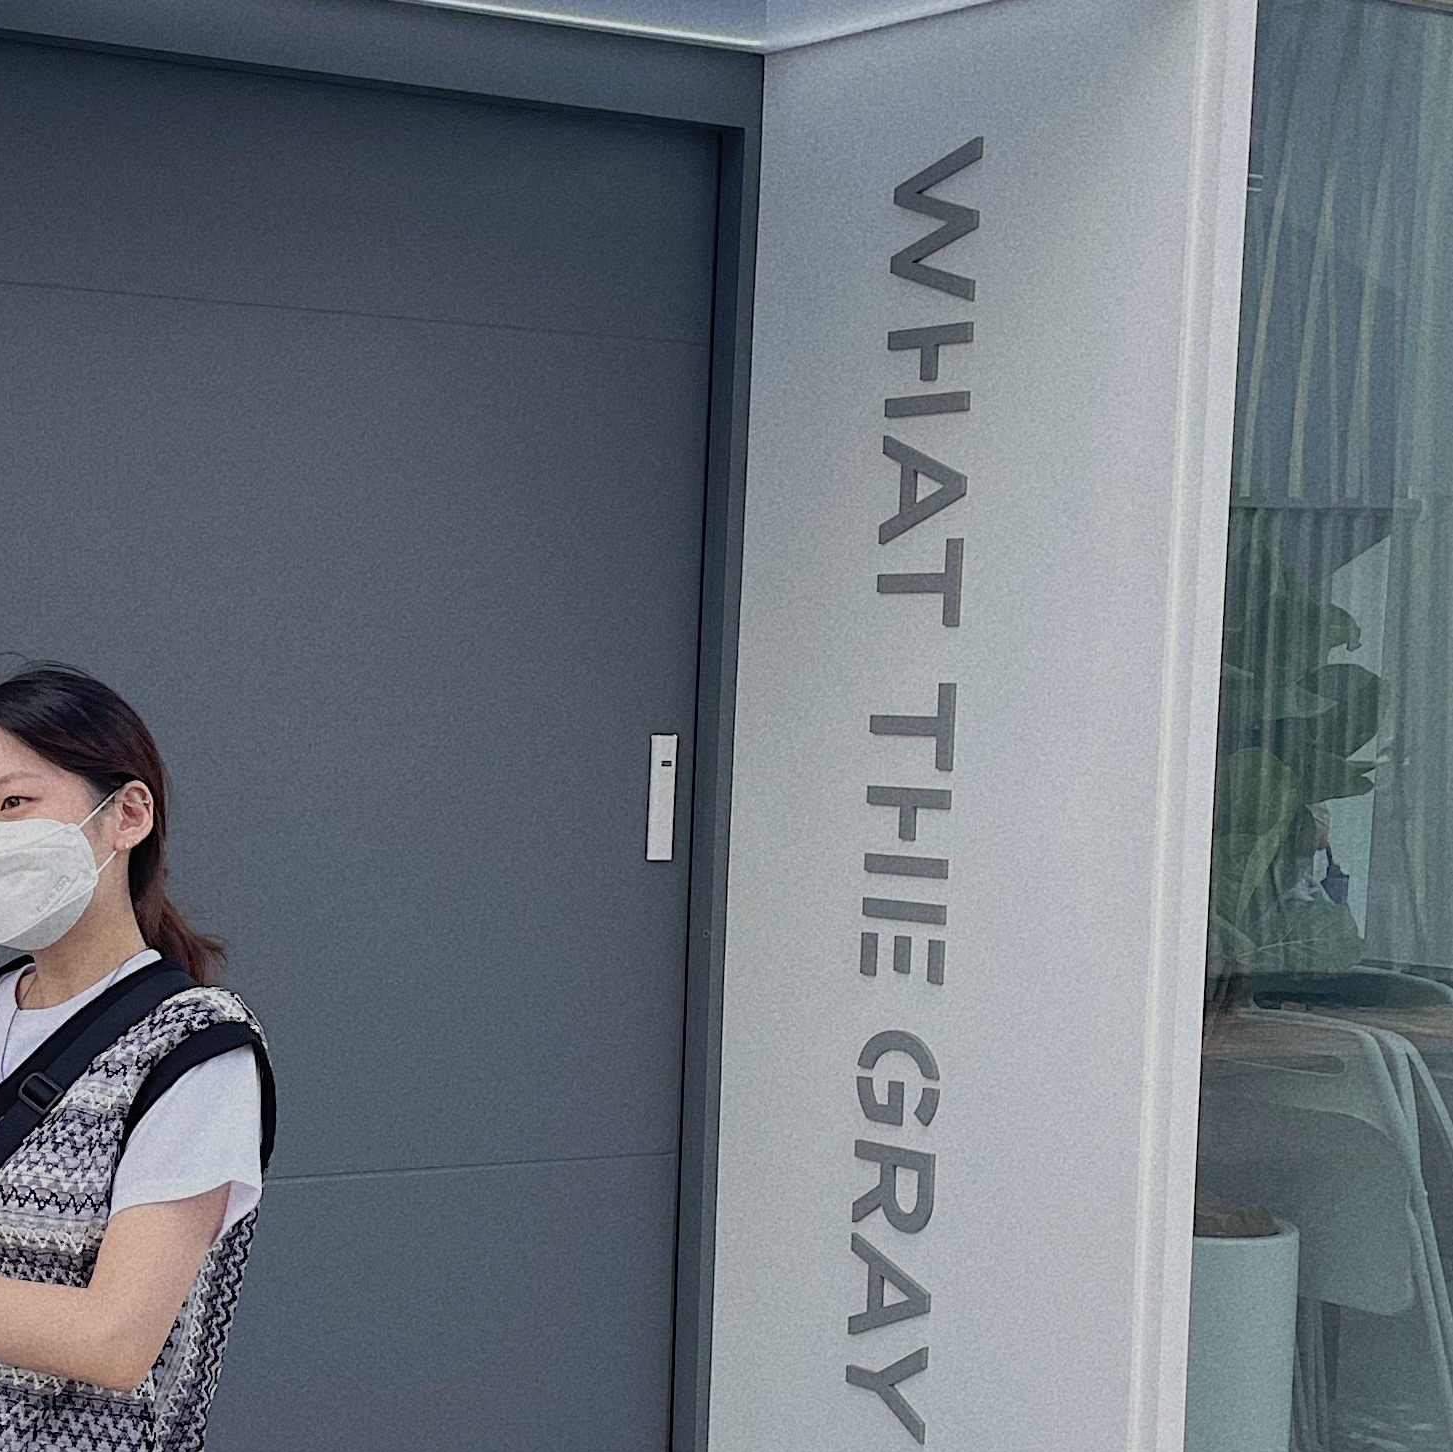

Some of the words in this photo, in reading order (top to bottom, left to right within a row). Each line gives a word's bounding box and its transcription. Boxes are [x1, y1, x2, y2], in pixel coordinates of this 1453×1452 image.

[876, 135, 985, 628] WHAT
[859, 682, 957, 986] THE
[845, 1030, 941, 1446] GRAY
